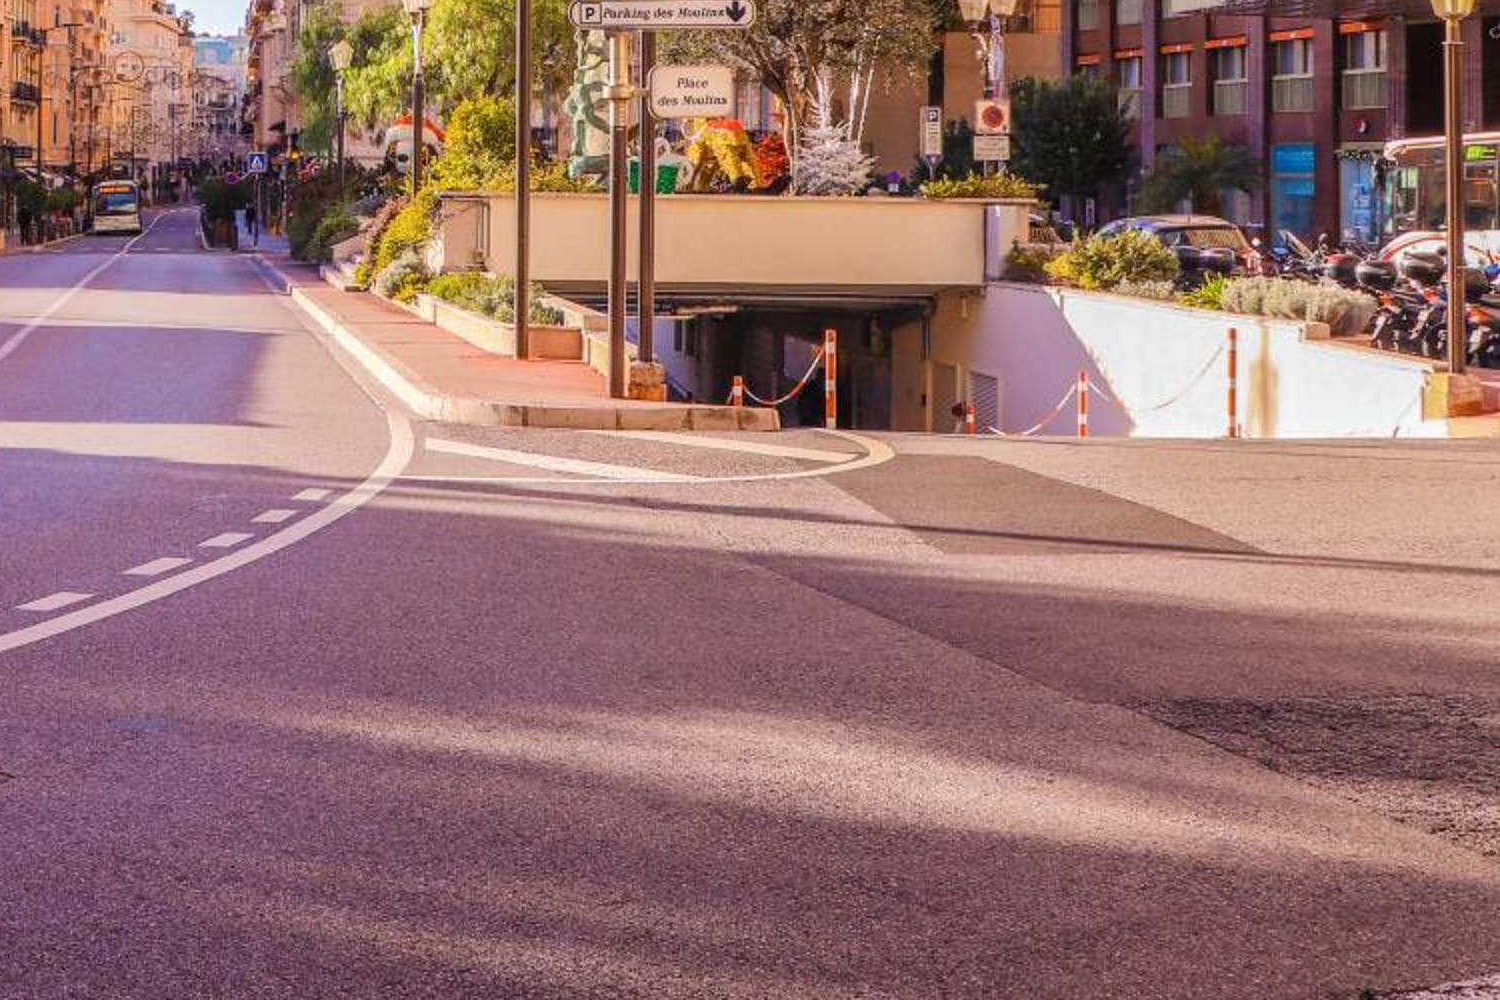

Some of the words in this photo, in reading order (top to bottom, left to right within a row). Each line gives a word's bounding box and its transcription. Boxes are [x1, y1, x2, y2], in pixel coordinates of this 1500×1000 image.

[585, 7, 596, 20] P
[603, 7, 651, 21] Parking
[653, 8, 674, 18] des
[678, 7, 725, 18] Moulins
[676, 77, 709, 89] Place
[658, 96, 678, 106] des
[682, 96, 728, 106] Moulins
